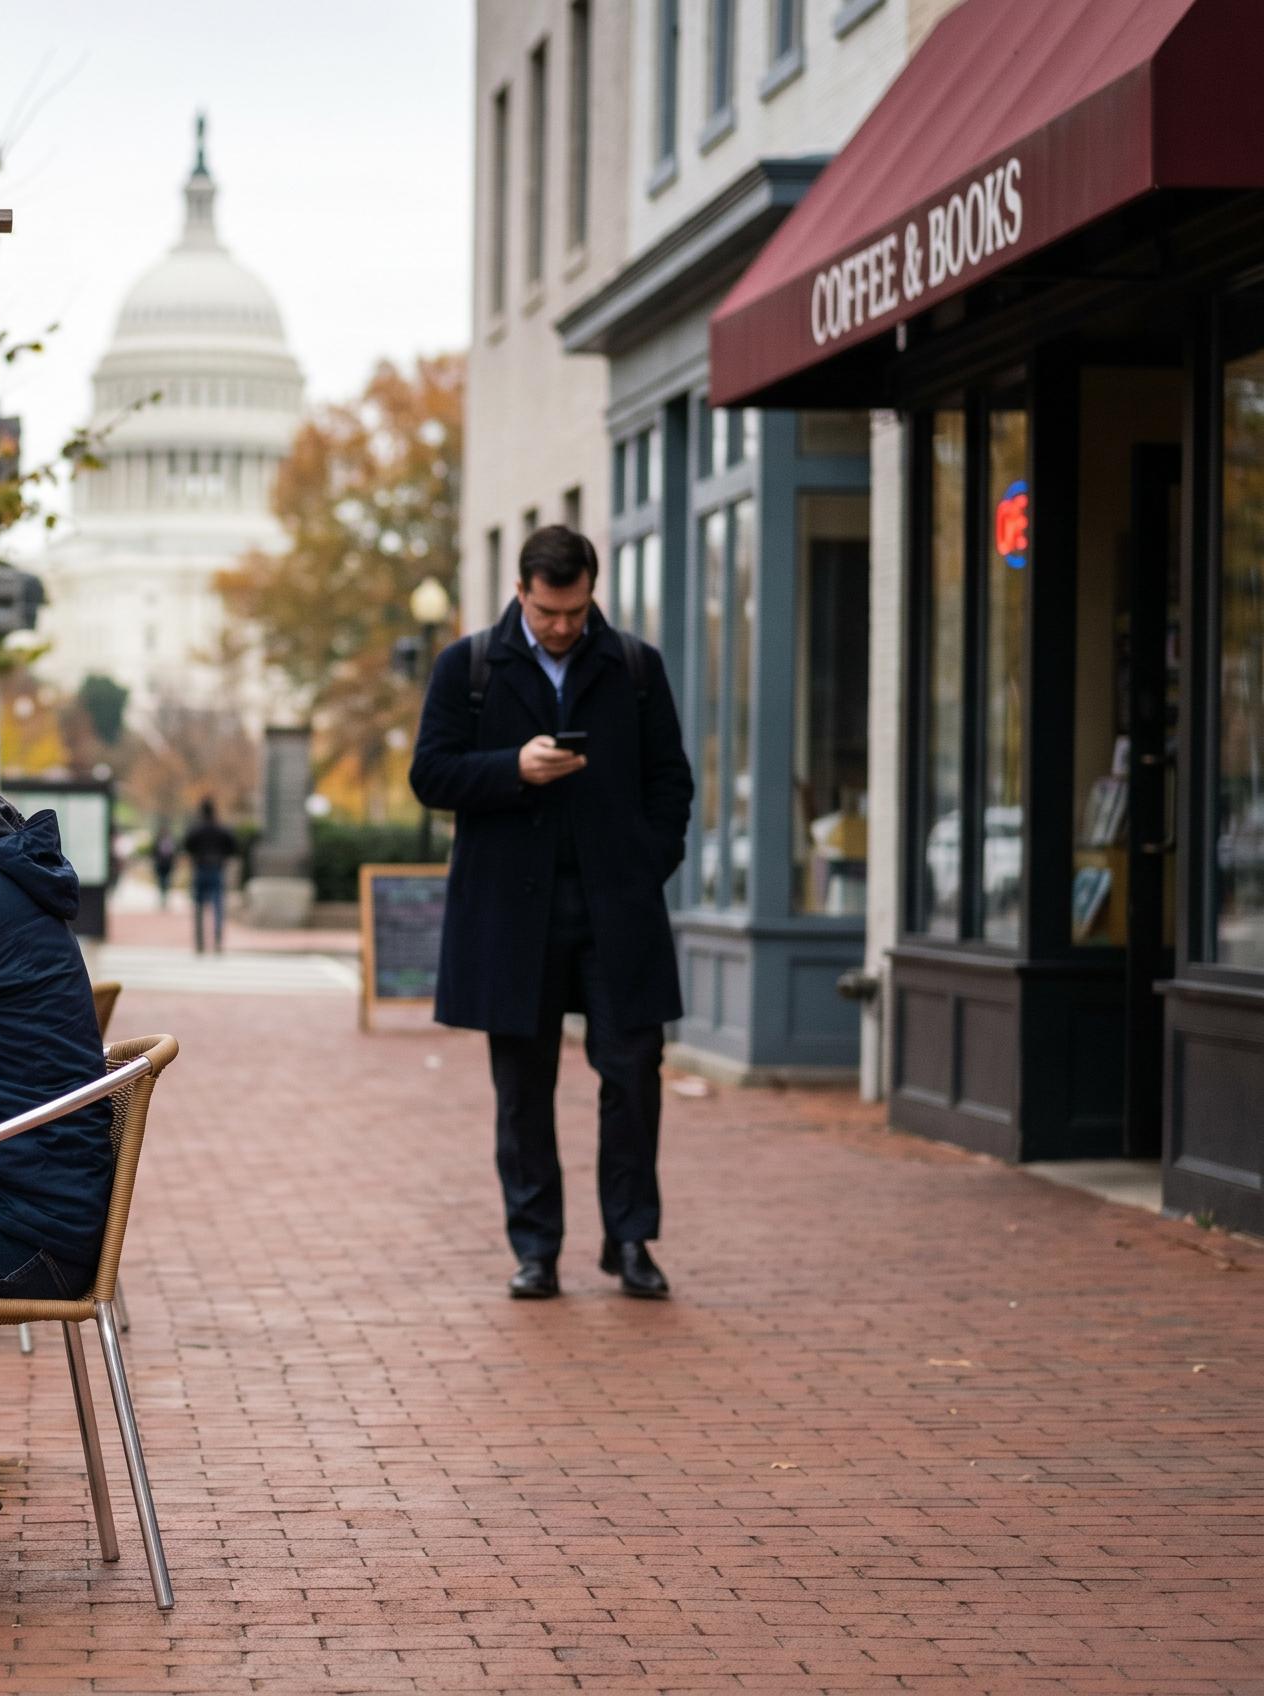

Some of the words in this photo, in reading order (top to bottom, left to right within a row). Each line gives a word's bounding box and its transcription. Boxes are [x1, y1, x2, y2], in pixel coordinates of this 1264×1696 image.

[811, 232, 899, 345] COFFEE
[903, 221, 924, 301] &
[928, 157, 1023, 288] BOOKS
